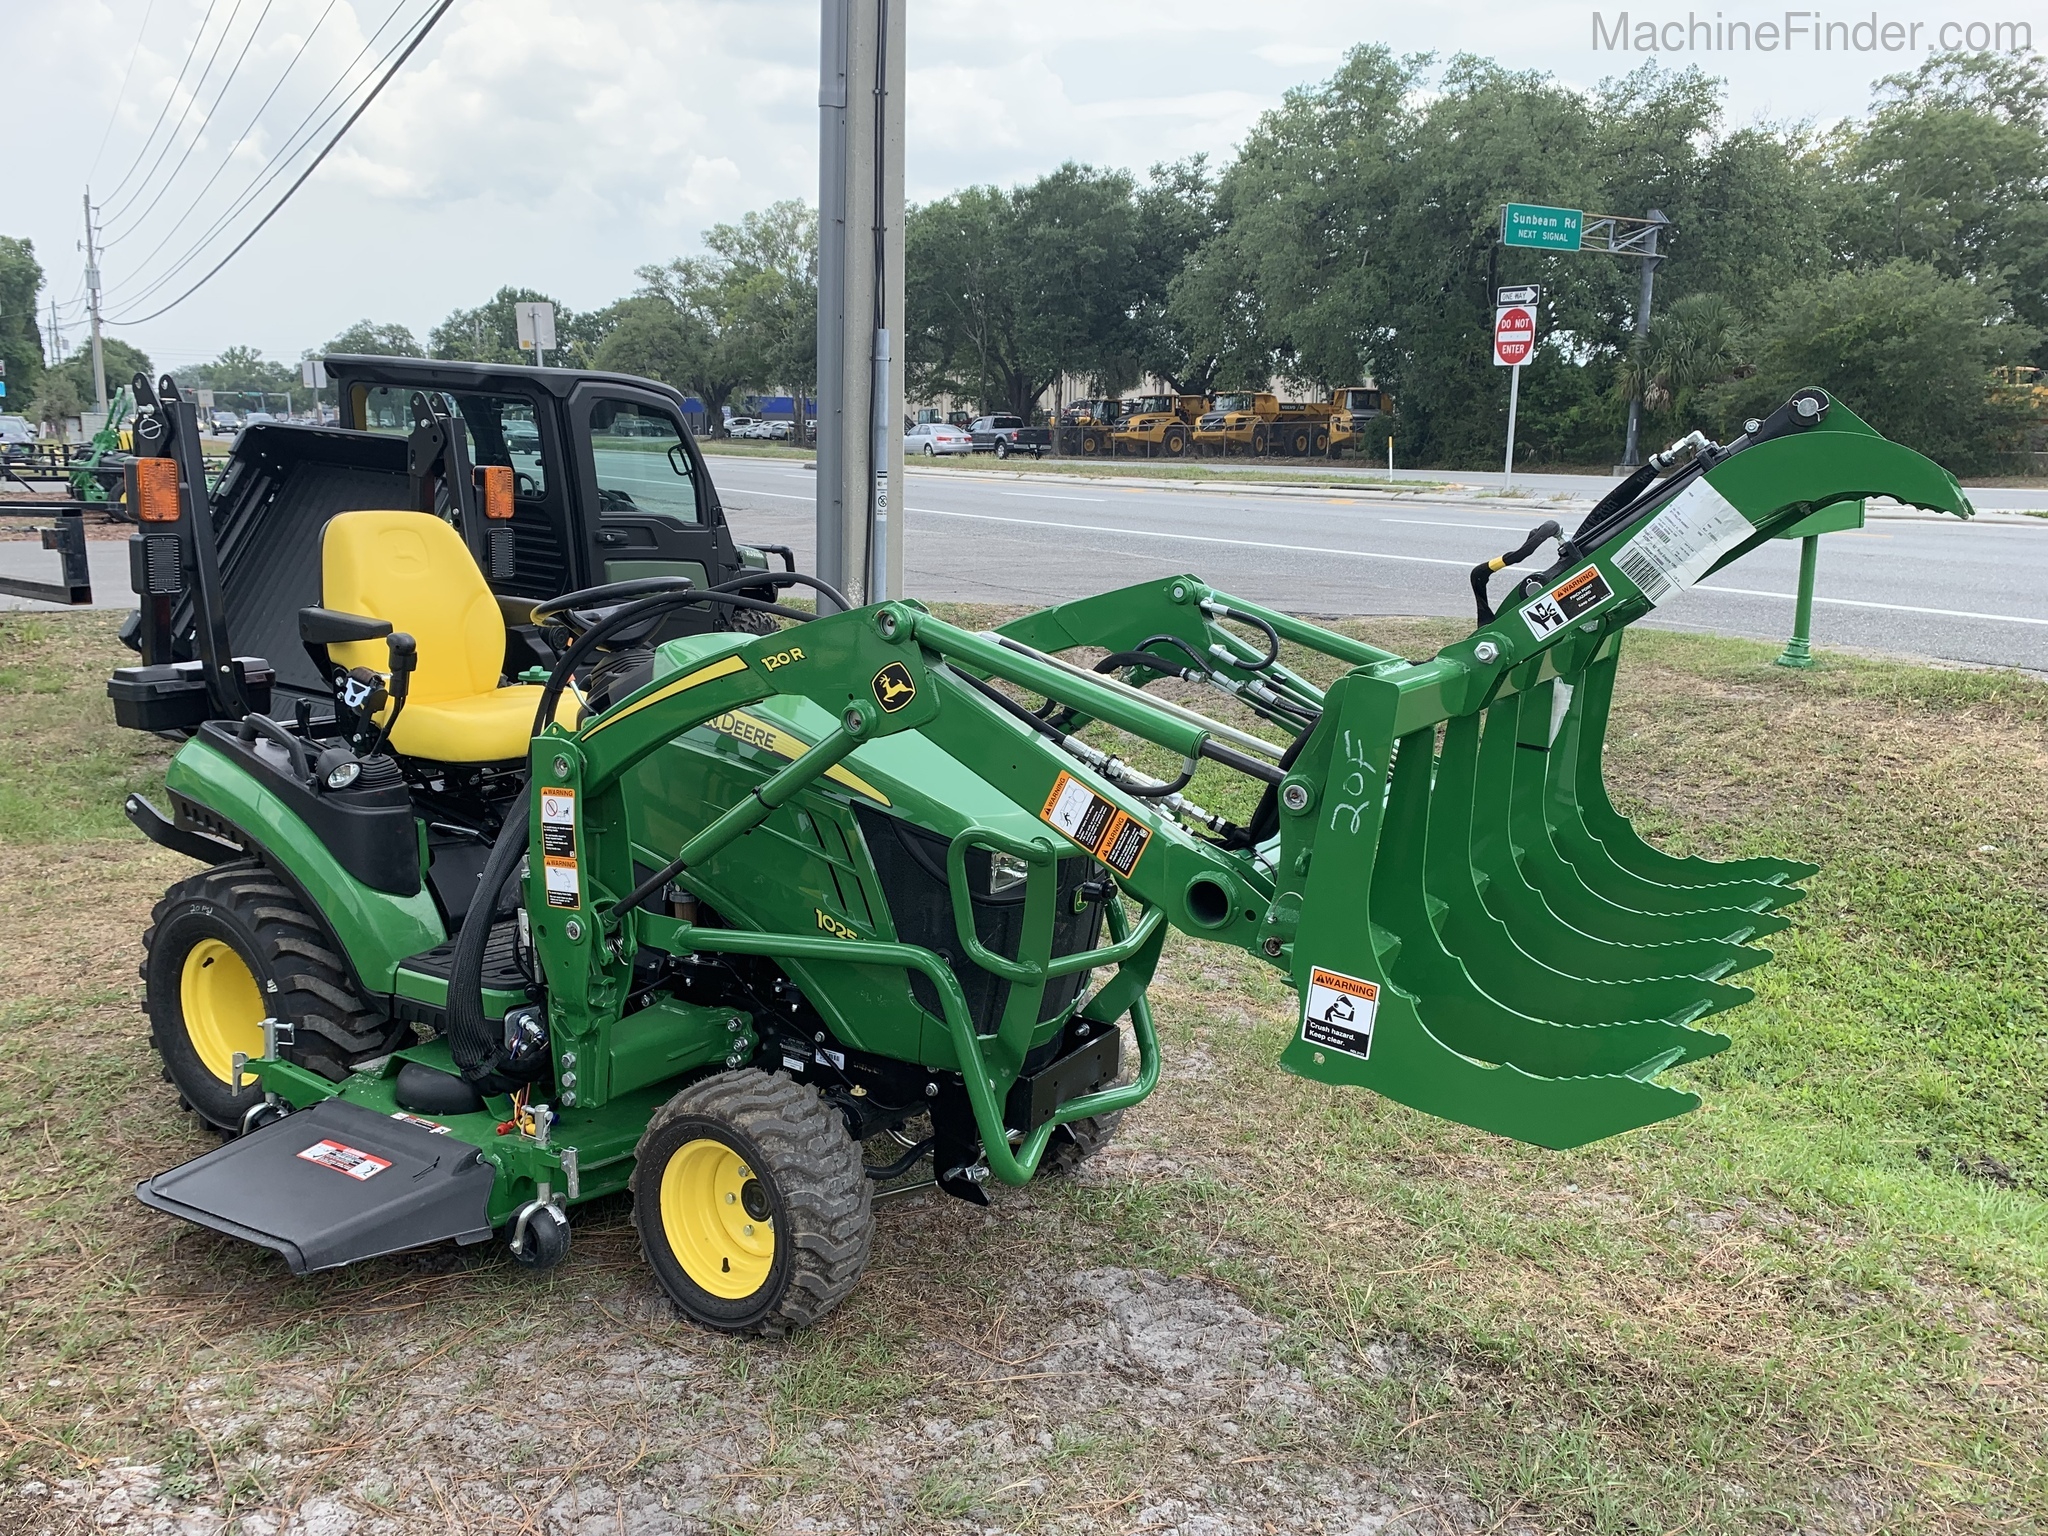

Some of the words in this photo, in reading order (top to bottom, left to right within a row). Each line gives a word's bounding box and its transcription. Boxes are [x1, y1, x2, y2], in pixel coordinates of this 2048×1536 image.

[1512, 212, 1558, 228] Sunbeam
[1564, 217, 1577, 229] Rd
[1518, 229, 1537, 239] NEXT
[1542, 231, 1569, 242] SIGNAL
[1502, 293, 1514, 301] ONE
[1514, 292, 1527, 300] WAY
[1501, 319, 1512, 329] DO
[1515, 318, 1530, 328] NOT
[1502, 344, 1525, 354] ENTER
[1562, 570, 1594, 593] WARNING
[547, 789, 573, 797] WARNING
[1047, 777, 1066, 807] WARNING
[1106, 817, 1125, 848] WARNING
[550, 861, 576, 869] WARNING
[1325, 975, 1374, 997] WARNING
[1309, 1021, 1330, 1033] Crush
[1331, 1028, 1356, 1041] hazard.
[1309, 1030, 1327, 1041] Keep
[1327, 1036, 1345, 1046] clear.
